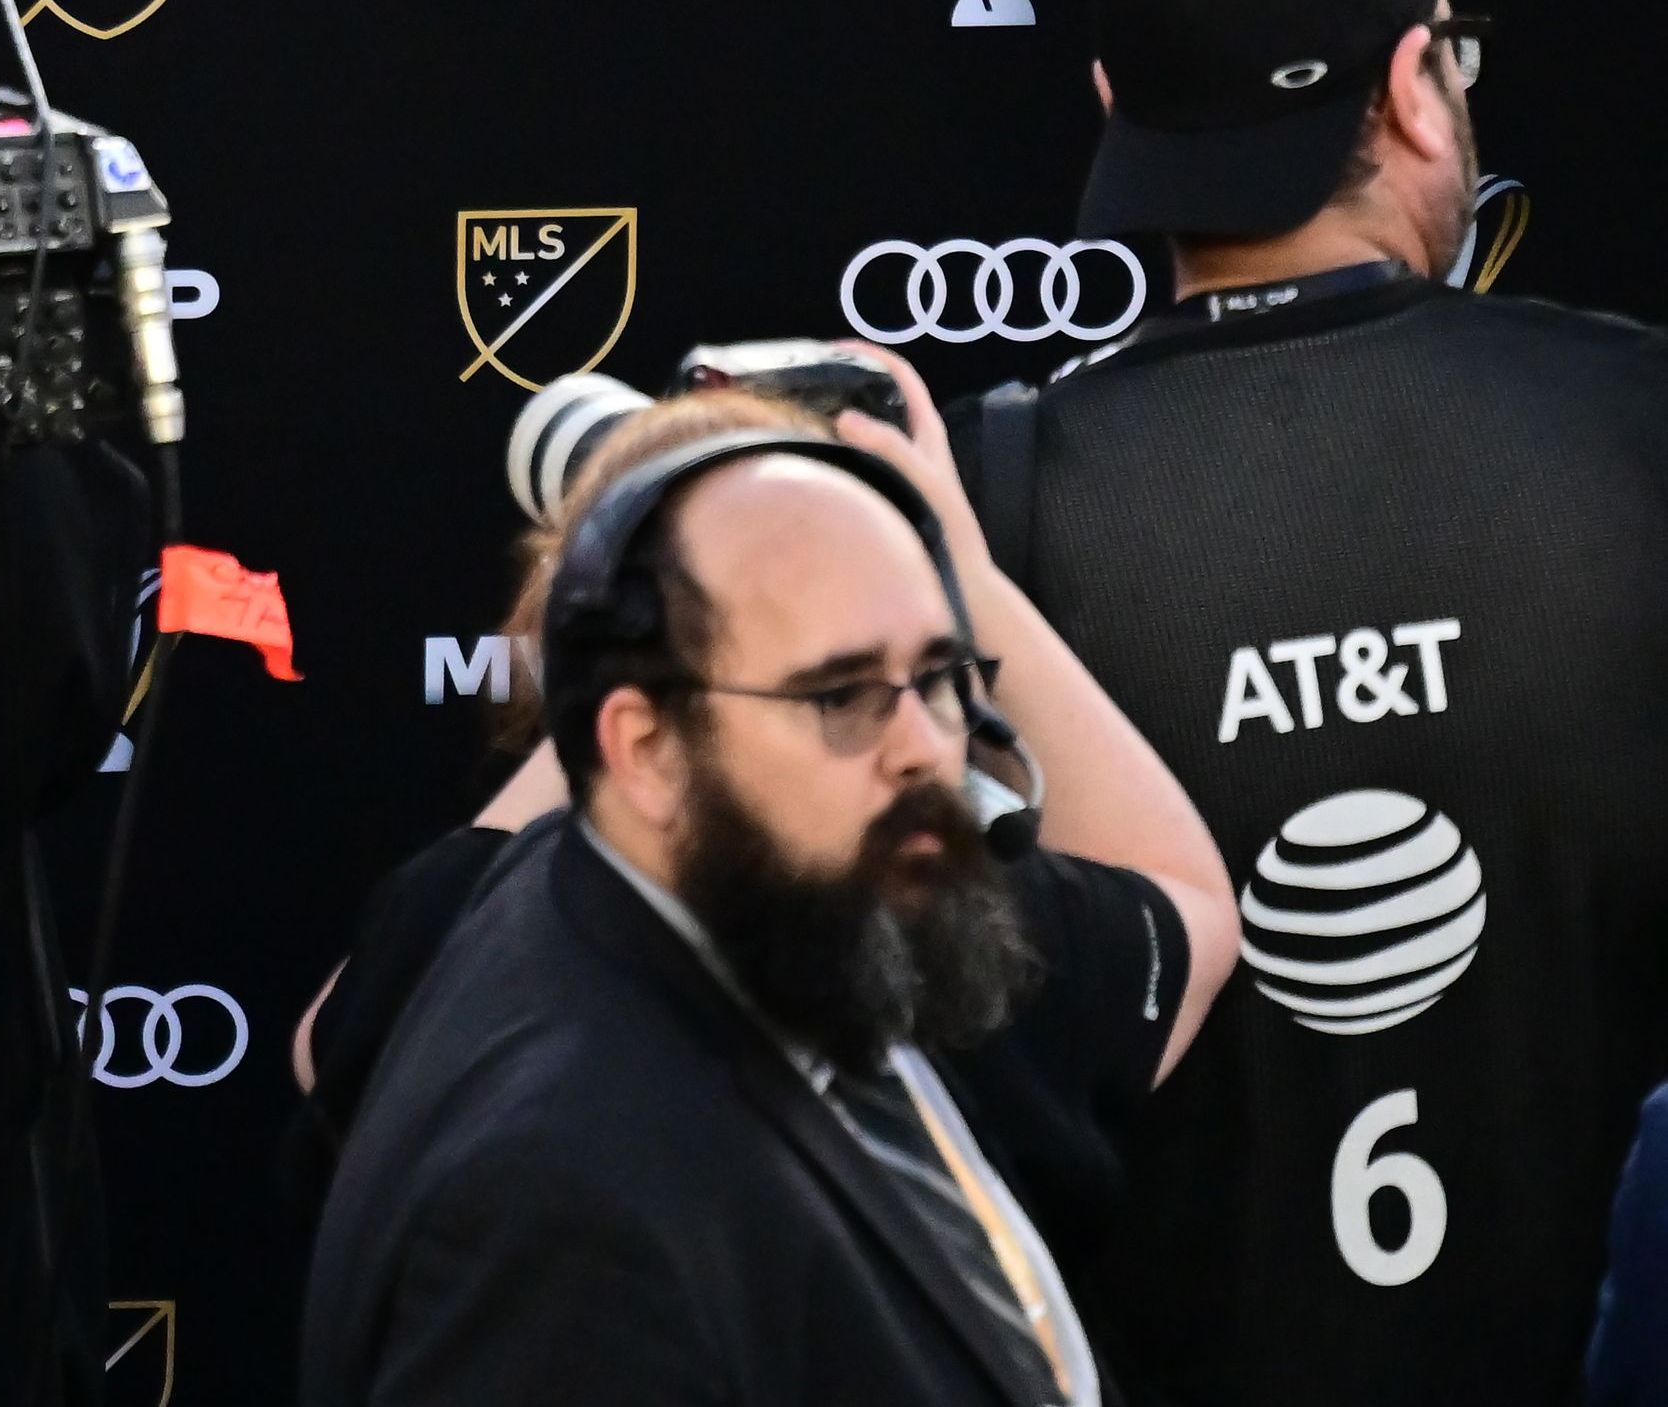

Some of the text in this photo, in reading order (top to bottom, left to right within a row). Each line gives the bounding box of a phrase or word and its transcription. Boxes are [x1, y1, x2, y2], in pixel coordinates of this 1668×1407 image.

[472, 223, 566, 262] MLS
[1217, 616, 1462, 744] AT&T
[1330, 1088, 1449, 1287] 6
